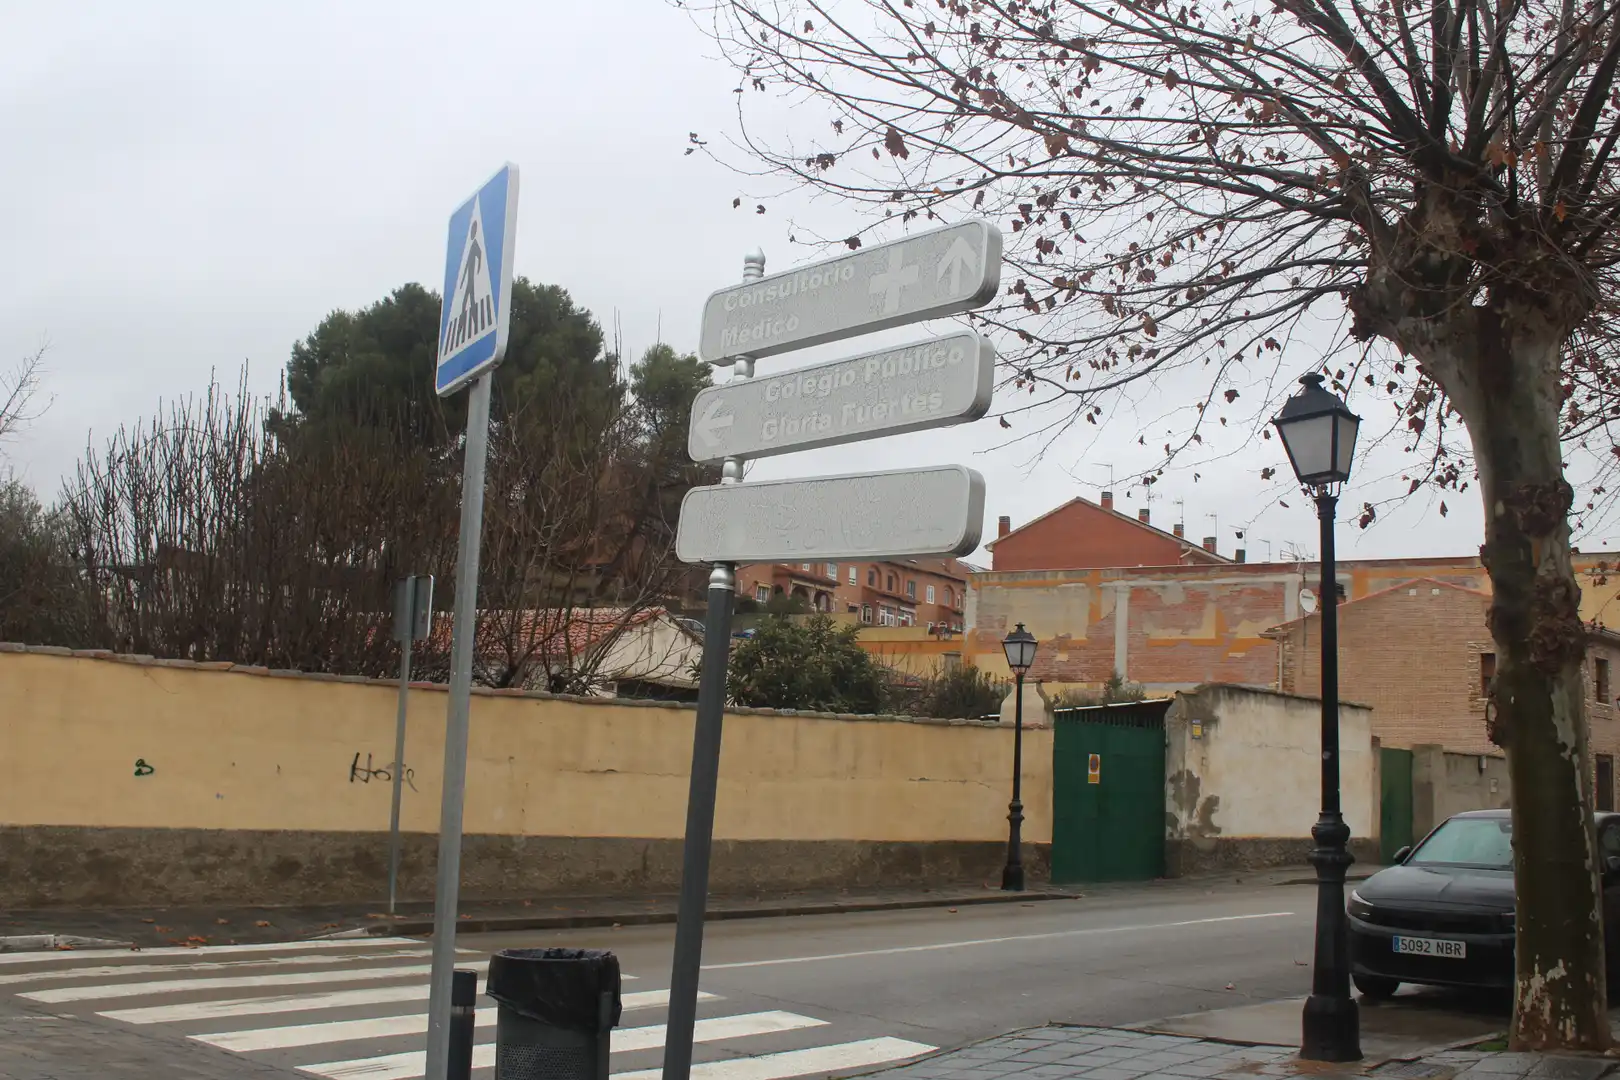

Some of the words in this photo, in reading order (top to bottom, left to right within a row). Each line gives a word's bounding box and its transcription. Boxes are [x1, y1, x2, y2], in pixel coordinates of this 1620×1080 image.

[724, 262, 855, 312] Consultorio
[765, 367, 856, 402] Colegio
[761, 410, 832, 441] Gloria
[841, 392, 944, 427] Fuertes
[1401, 938, 1431, 954] 5092
[1436, 941, 1462, 956] NBR
